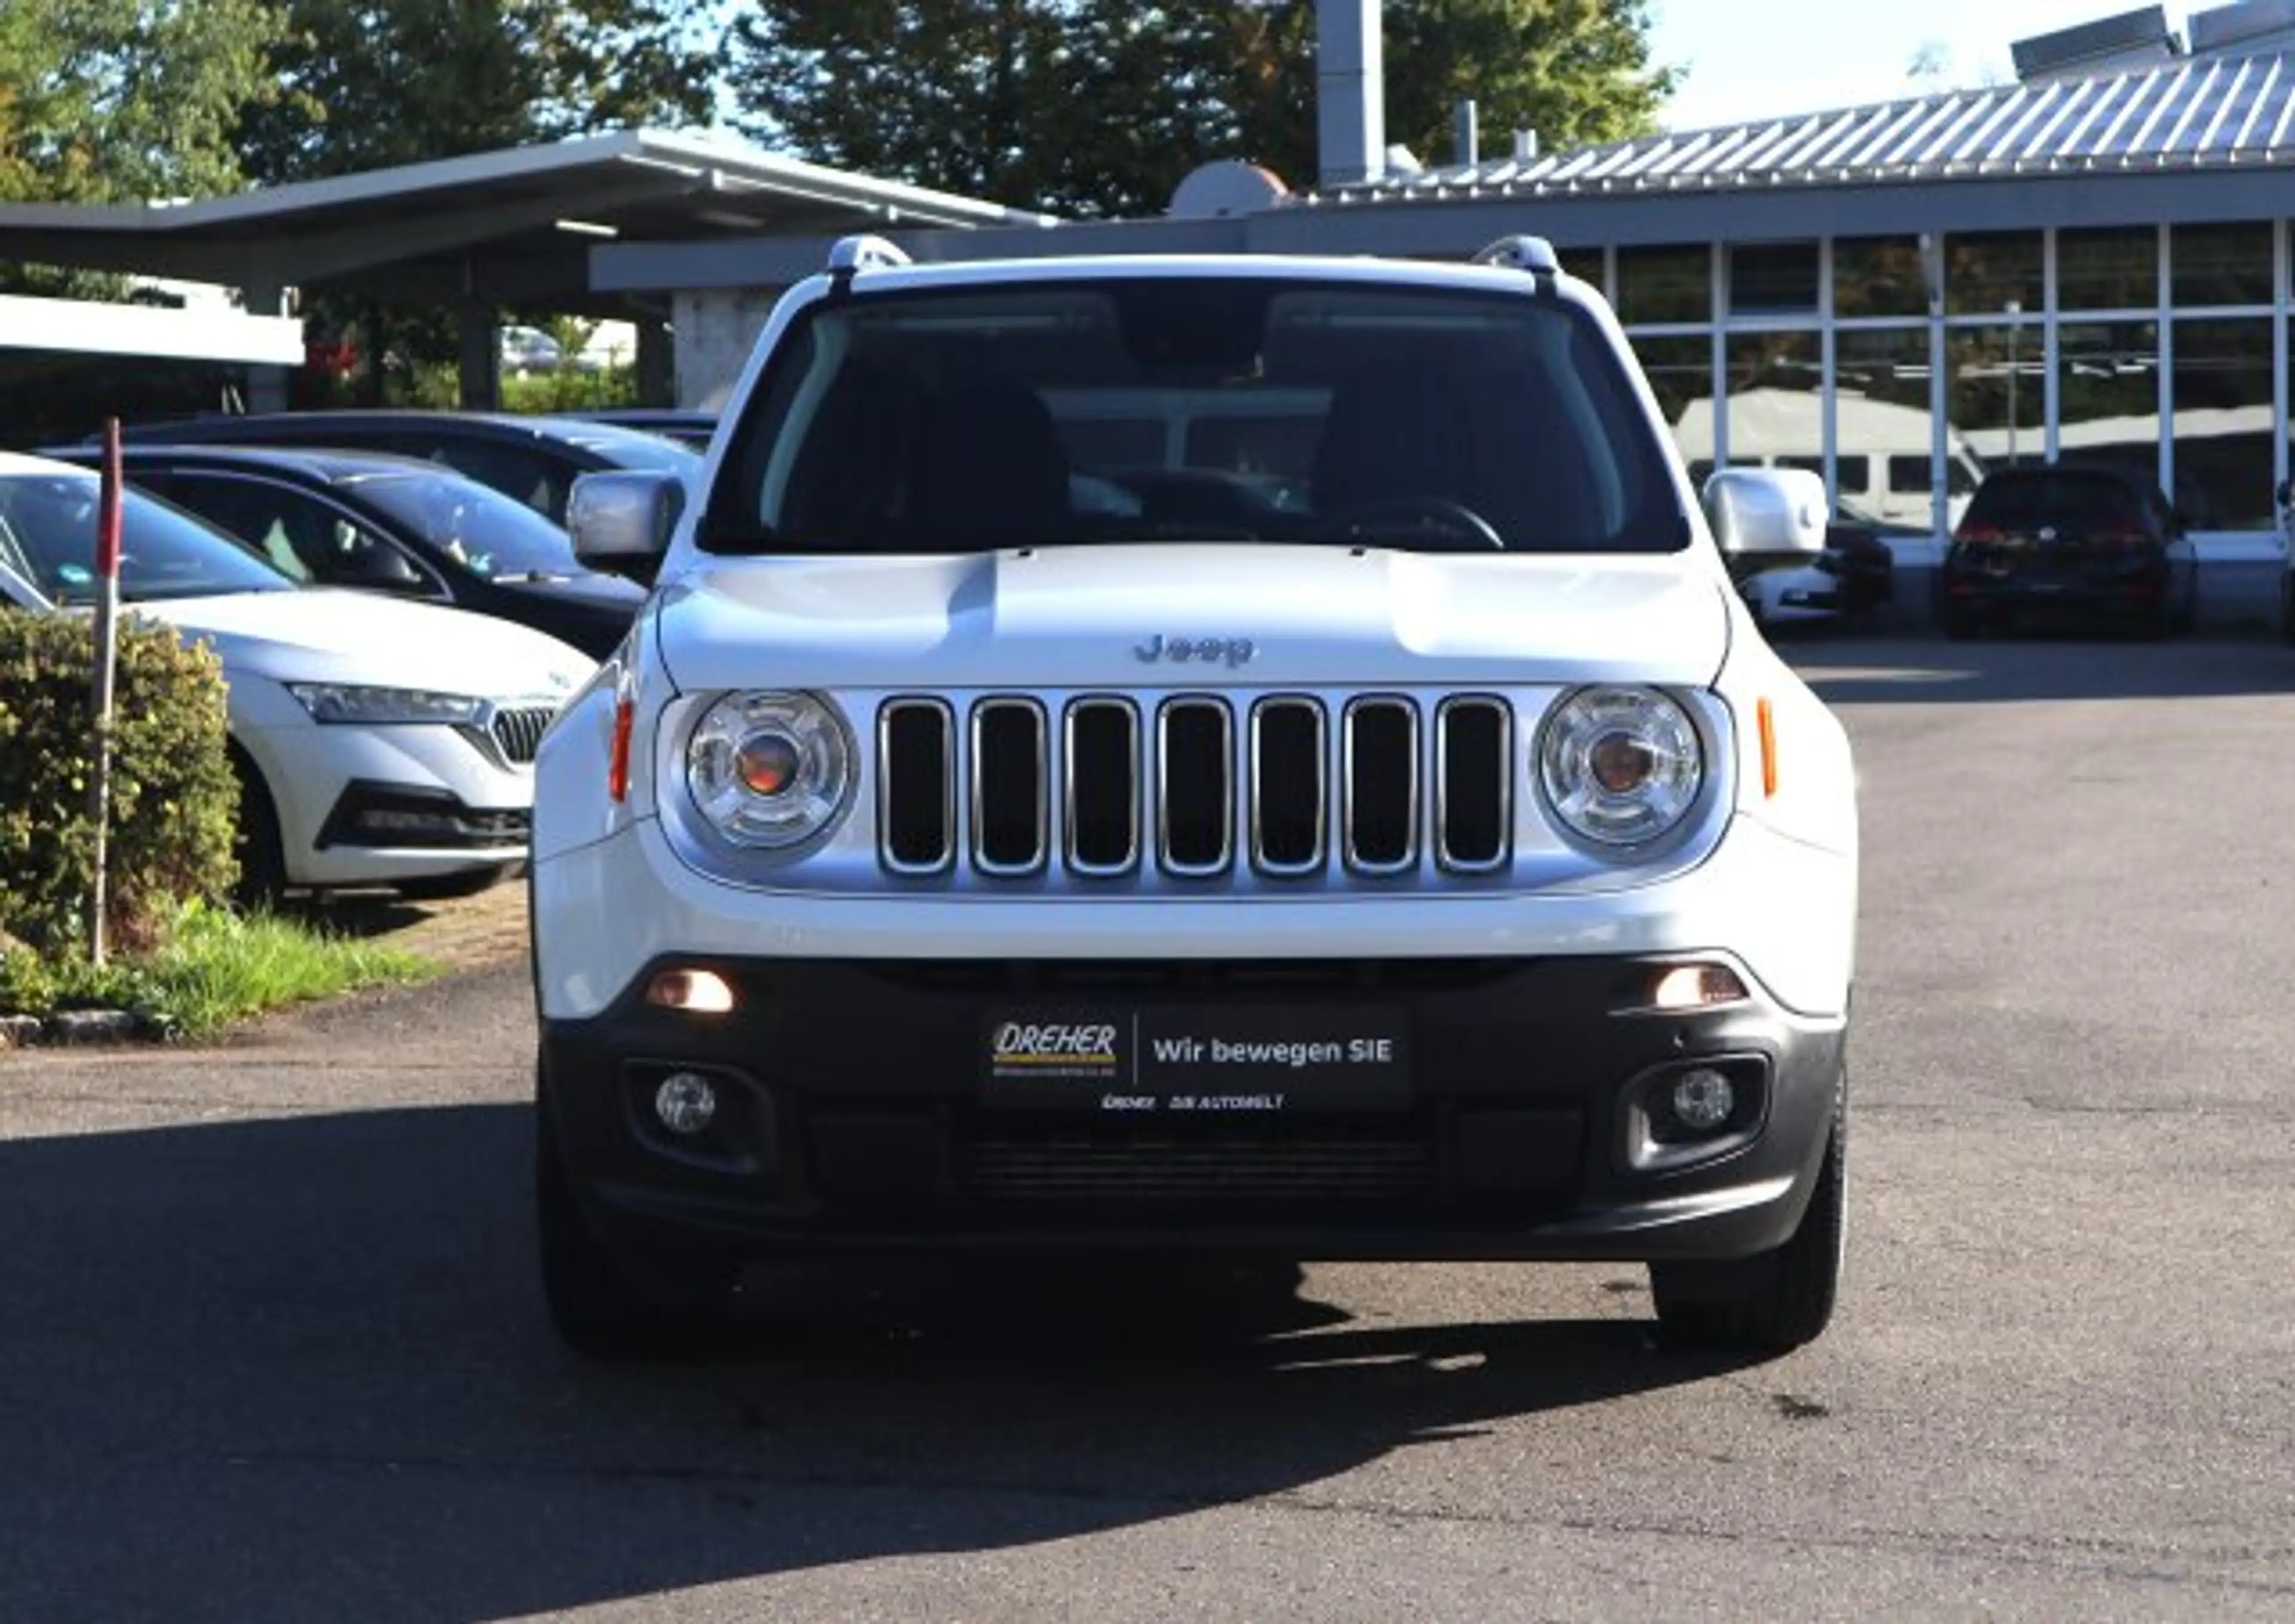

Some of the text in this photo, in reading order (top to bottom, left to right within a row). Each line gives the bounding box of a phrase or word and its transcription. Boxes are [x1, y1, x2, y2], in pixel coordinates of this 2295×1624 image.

[1133, 633, 1255, 669] Jeep
[995, 1022, 1116, 1056] DREHER
[1153, 1037, 1393, 1068] Wir bewegen SIE
